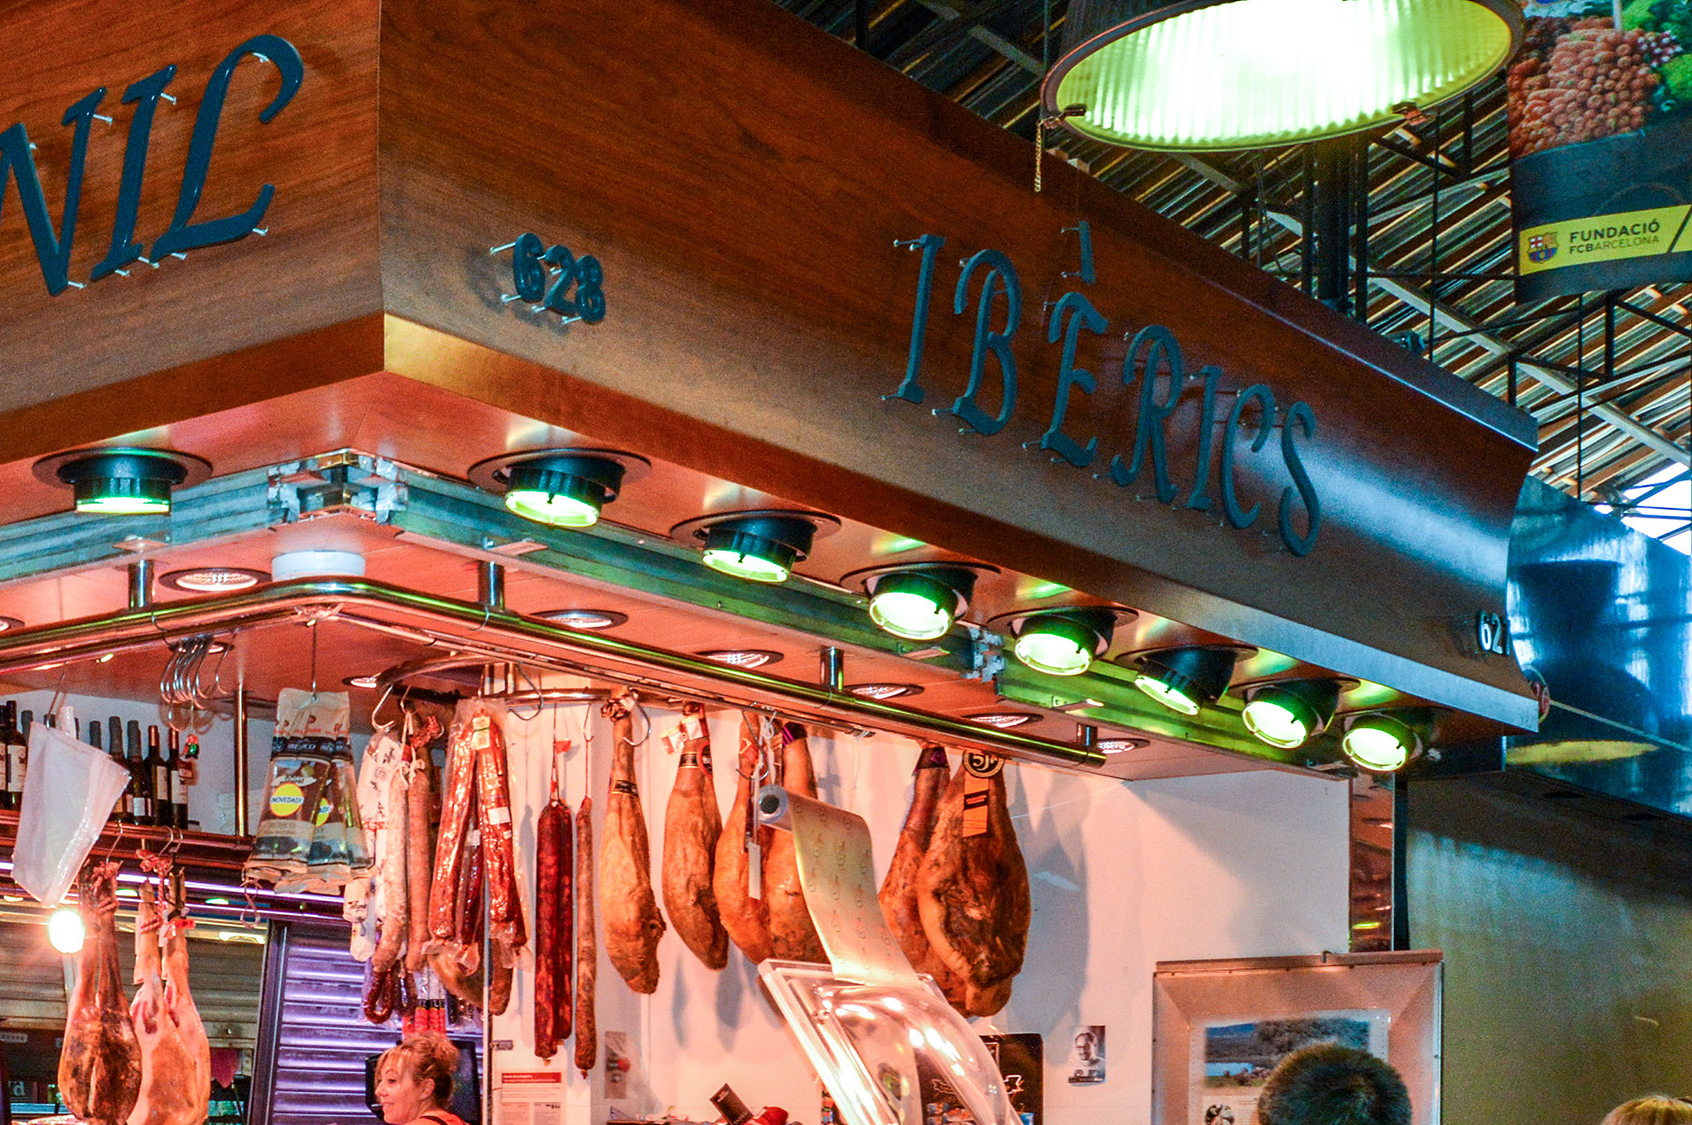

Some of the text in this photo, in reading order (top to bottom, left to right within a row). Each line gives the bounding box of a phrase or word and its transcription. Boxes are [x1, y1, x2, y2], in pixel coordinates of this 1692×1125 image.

[1569, 218, 1661, 244] FUNDACIÓ
[1569, 234, 1660, 255] FCBARCELONA
[512, 232, 607, 325] 628
[897, 220, 1322, 557] IBÈRICS
[1477, 609, 1511, 656] 62
